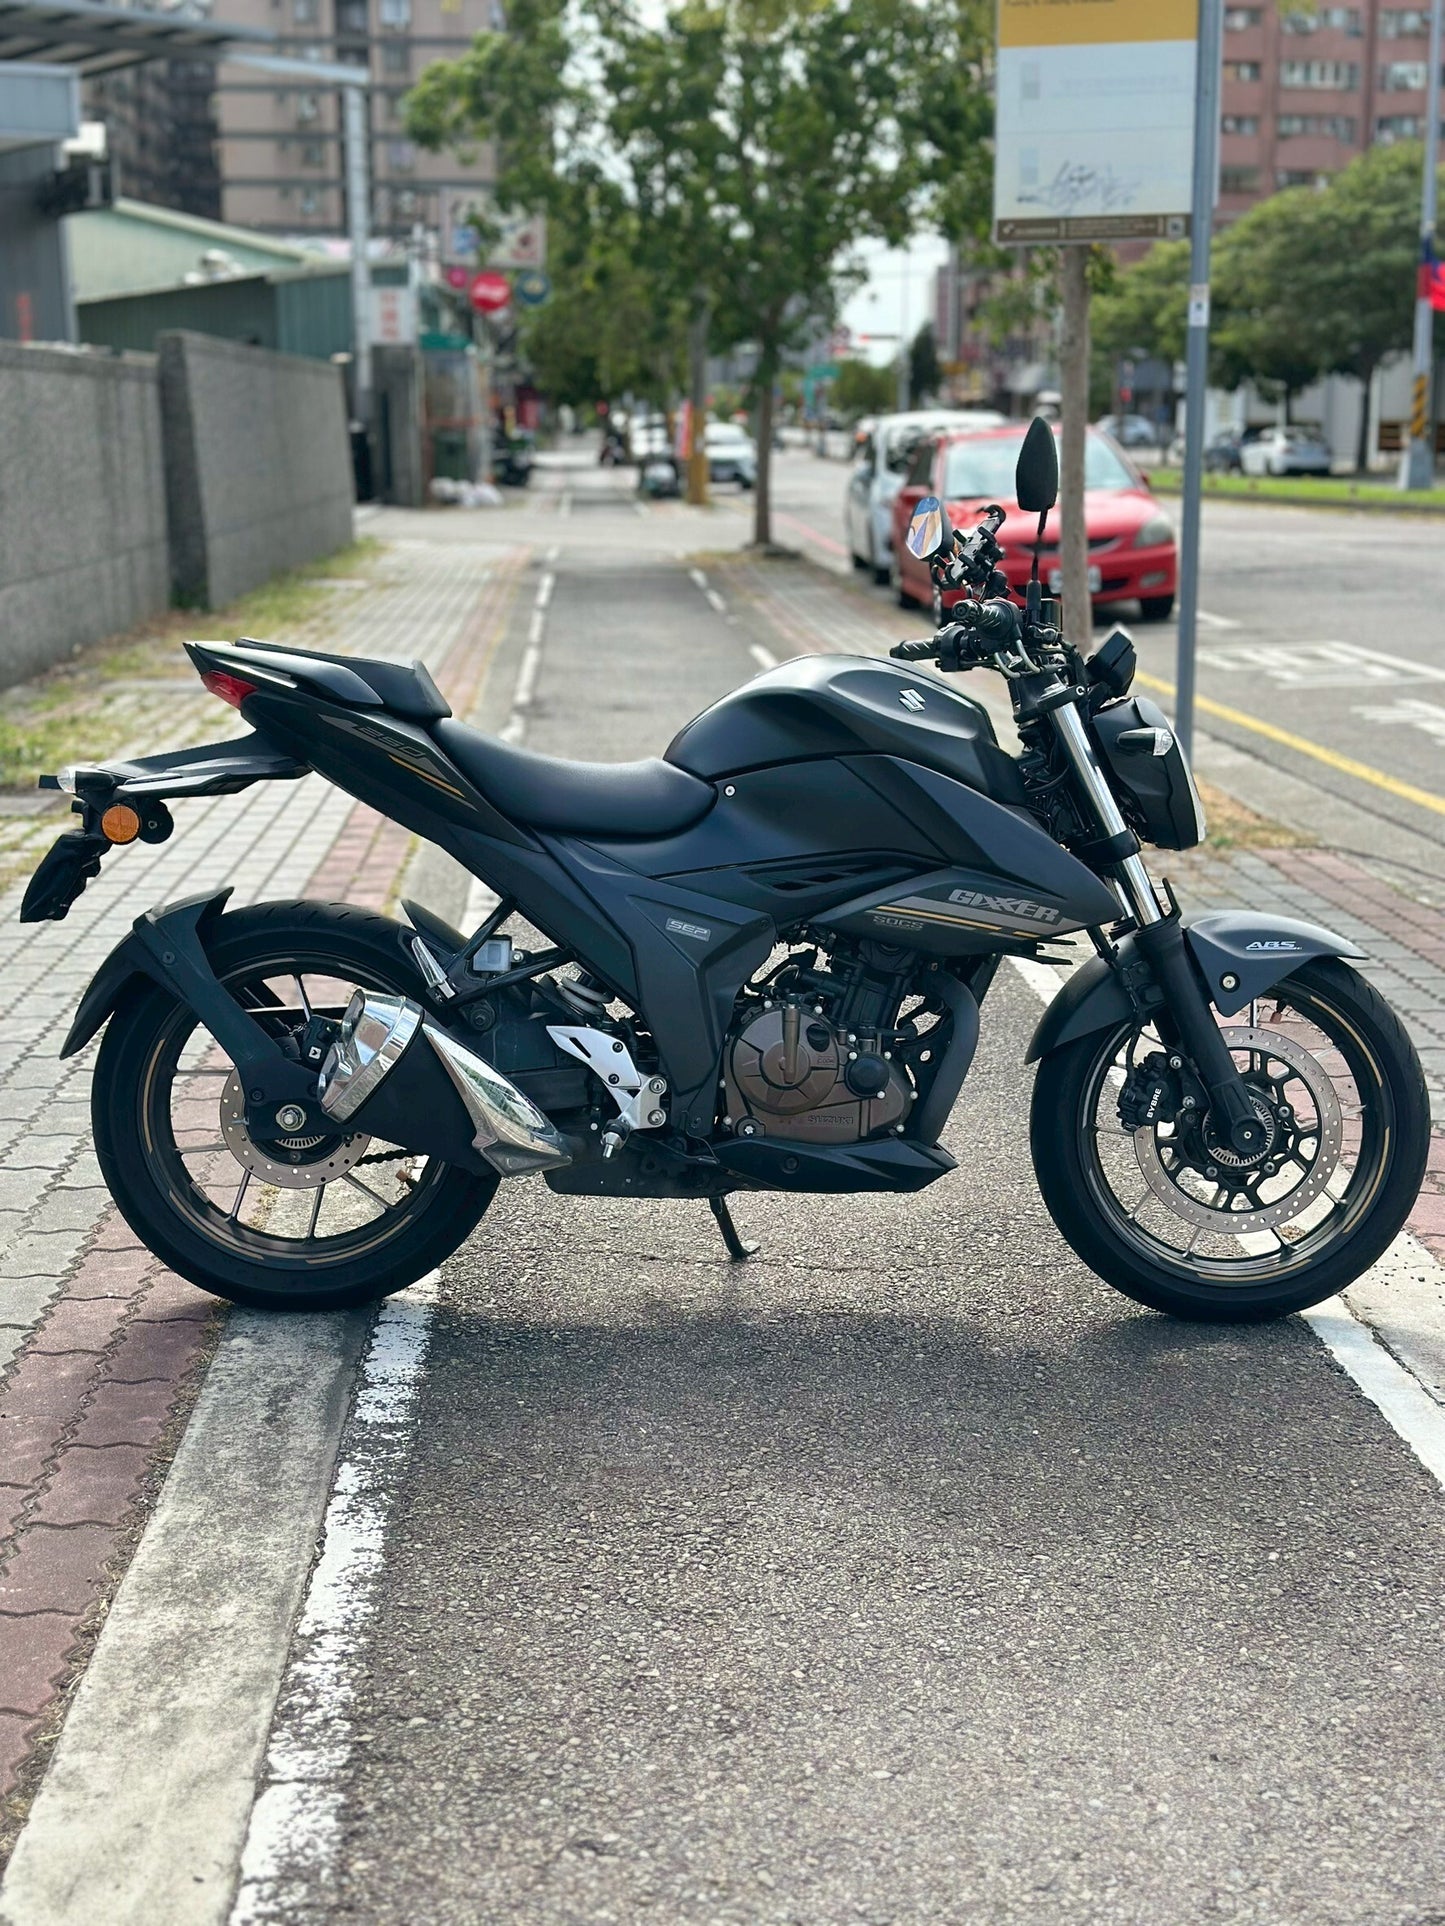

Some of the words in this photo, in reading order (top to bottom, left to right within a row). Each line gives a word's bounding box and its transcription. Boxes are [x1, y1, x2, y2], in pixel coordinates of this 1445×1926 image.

[948, 889, 1060, 922] GIXXER
[668, 920, 708, 934] SEP
[872, 915, 924, 930] SOCS
[1246, 941, 1297, 950] ABS
[1146, 1087, 1162, 1118] BYBRE
[808, 1114, 854, 1124] SUZUKI
